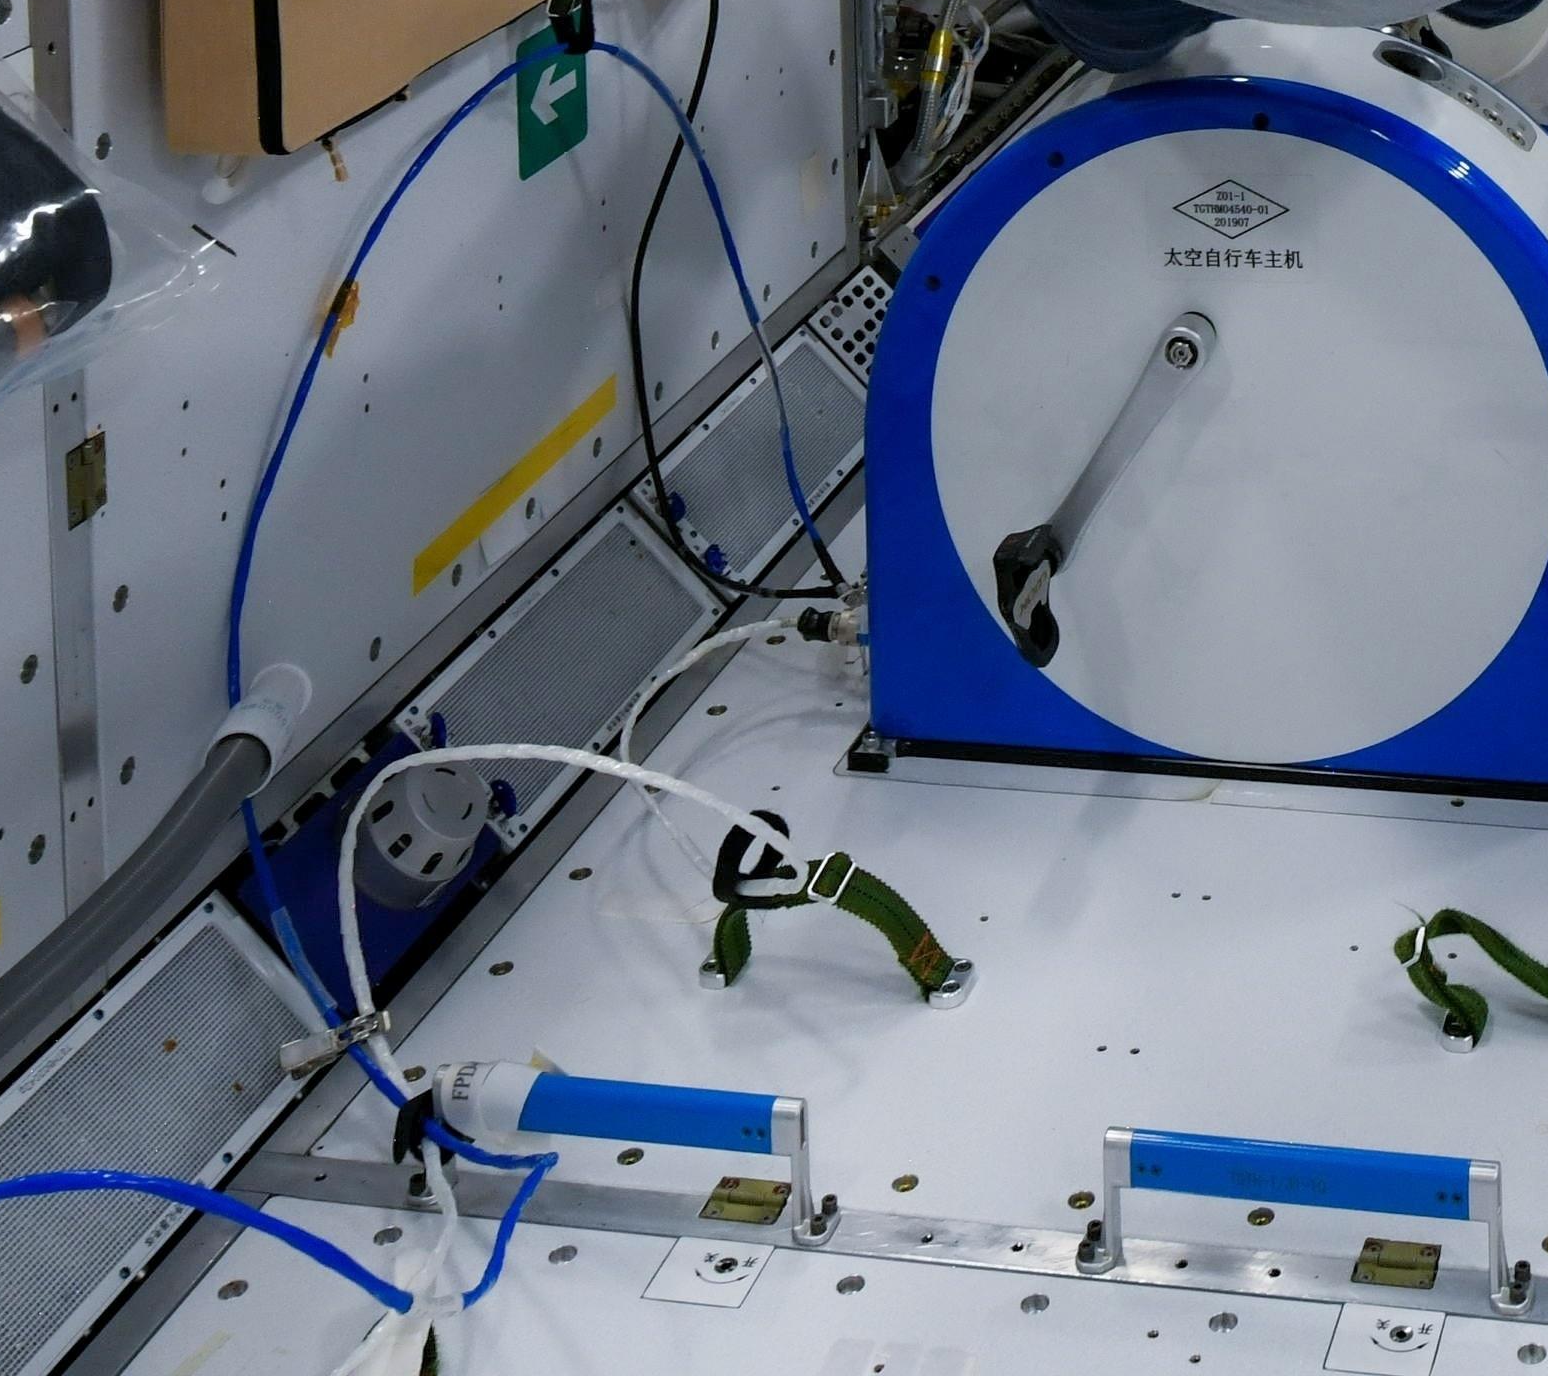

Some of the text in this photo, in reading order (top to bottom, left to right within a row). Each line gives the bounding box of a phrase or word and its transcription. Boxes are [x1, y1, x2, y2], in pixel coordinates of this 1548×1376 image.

[1215, 191, 1247, 202] Z01-1
[1213, 216, 1250, 228] 201907
[1163, 246, 1304, 272] 太空自行车主机
[703, 1252, 759, 1268] 关 开
[1375, 1318, 1433, 1335] 关 开
